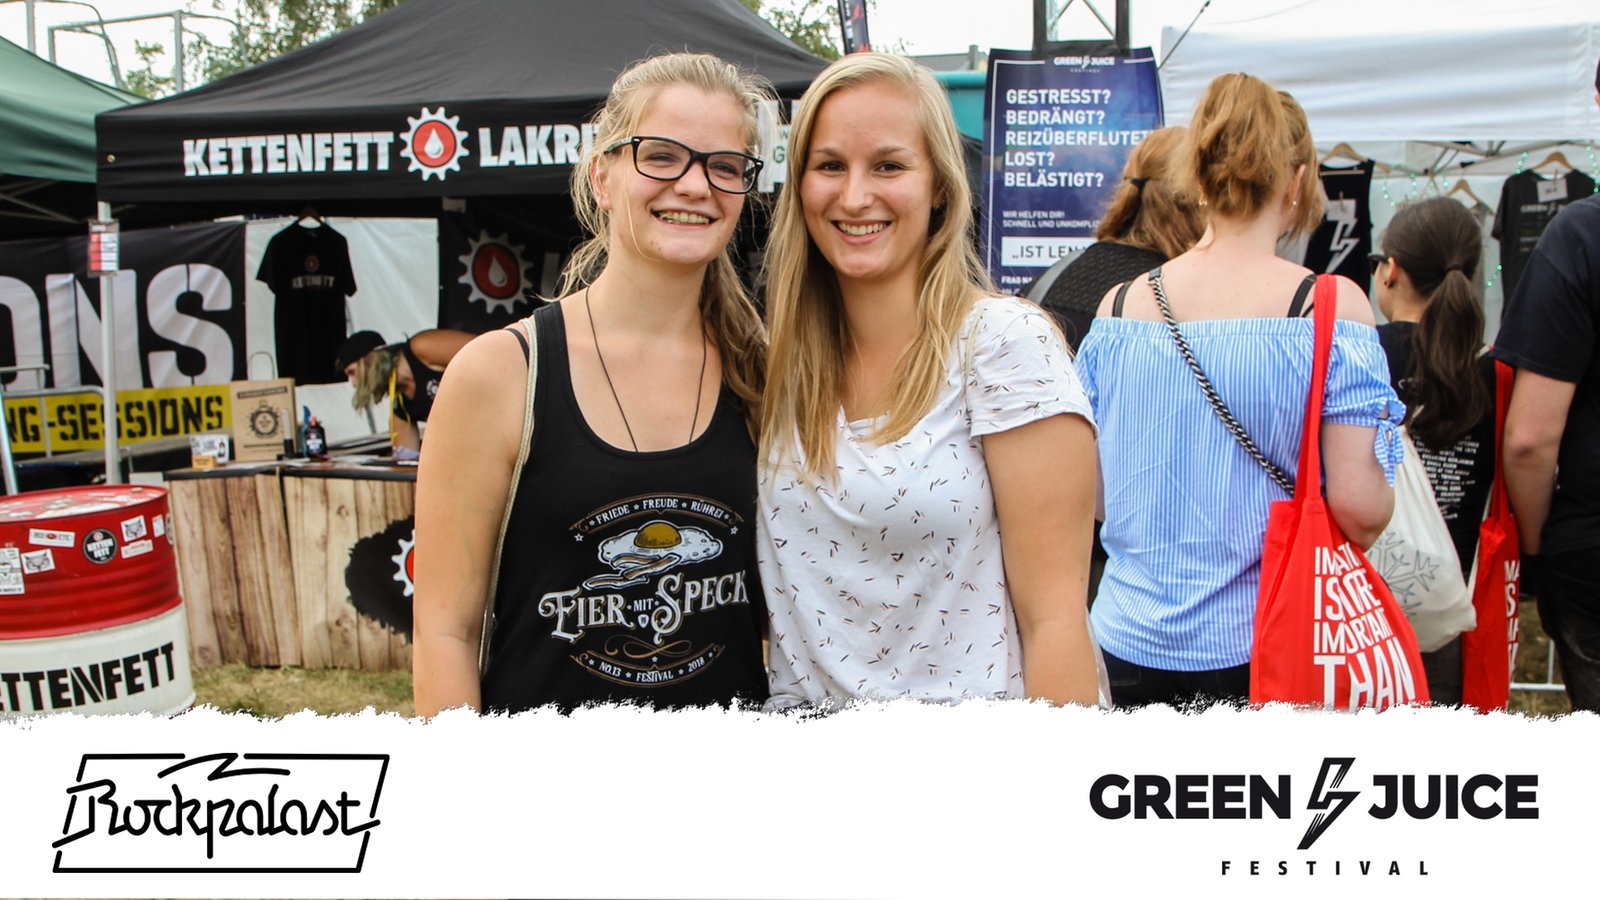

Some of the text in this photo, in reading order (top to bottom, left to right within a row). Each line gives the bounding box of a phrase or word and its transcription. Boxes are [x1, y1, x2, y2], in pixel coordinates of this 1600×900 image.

[1053, 56, 1115, 66] GREEN JUICE
[1006, 89, 1111, 104] GESTRESST?
[1006, 107, 1105, 125] BEDRÄNGT?
[183, 123, 601, 177] KETTENFETT LAKRI
[1005, 152, 1055, 166] LOST?
[1004, 169, 1104, 187] BELÄSTIGT?
[1002, 210, 1018, 219] WIR
[1018, 210, 1048, 219] HELFEN
[1002, 220, 1037, 228] SCHNELL
[1038, 220, 1055, 228] UND
[595, 504, 631, 525] FRIEDE
[642, 498, 679, 510] FREUDE
[538, 570, 750, 646] EIER MIT SPECK
[0, 641, 175, 712] TTENFETT
[635, 670, 674, 683] FESTIVAL
[688, 657, 705, 673] 2018
[1313, 636, 1416, 715] THAN
